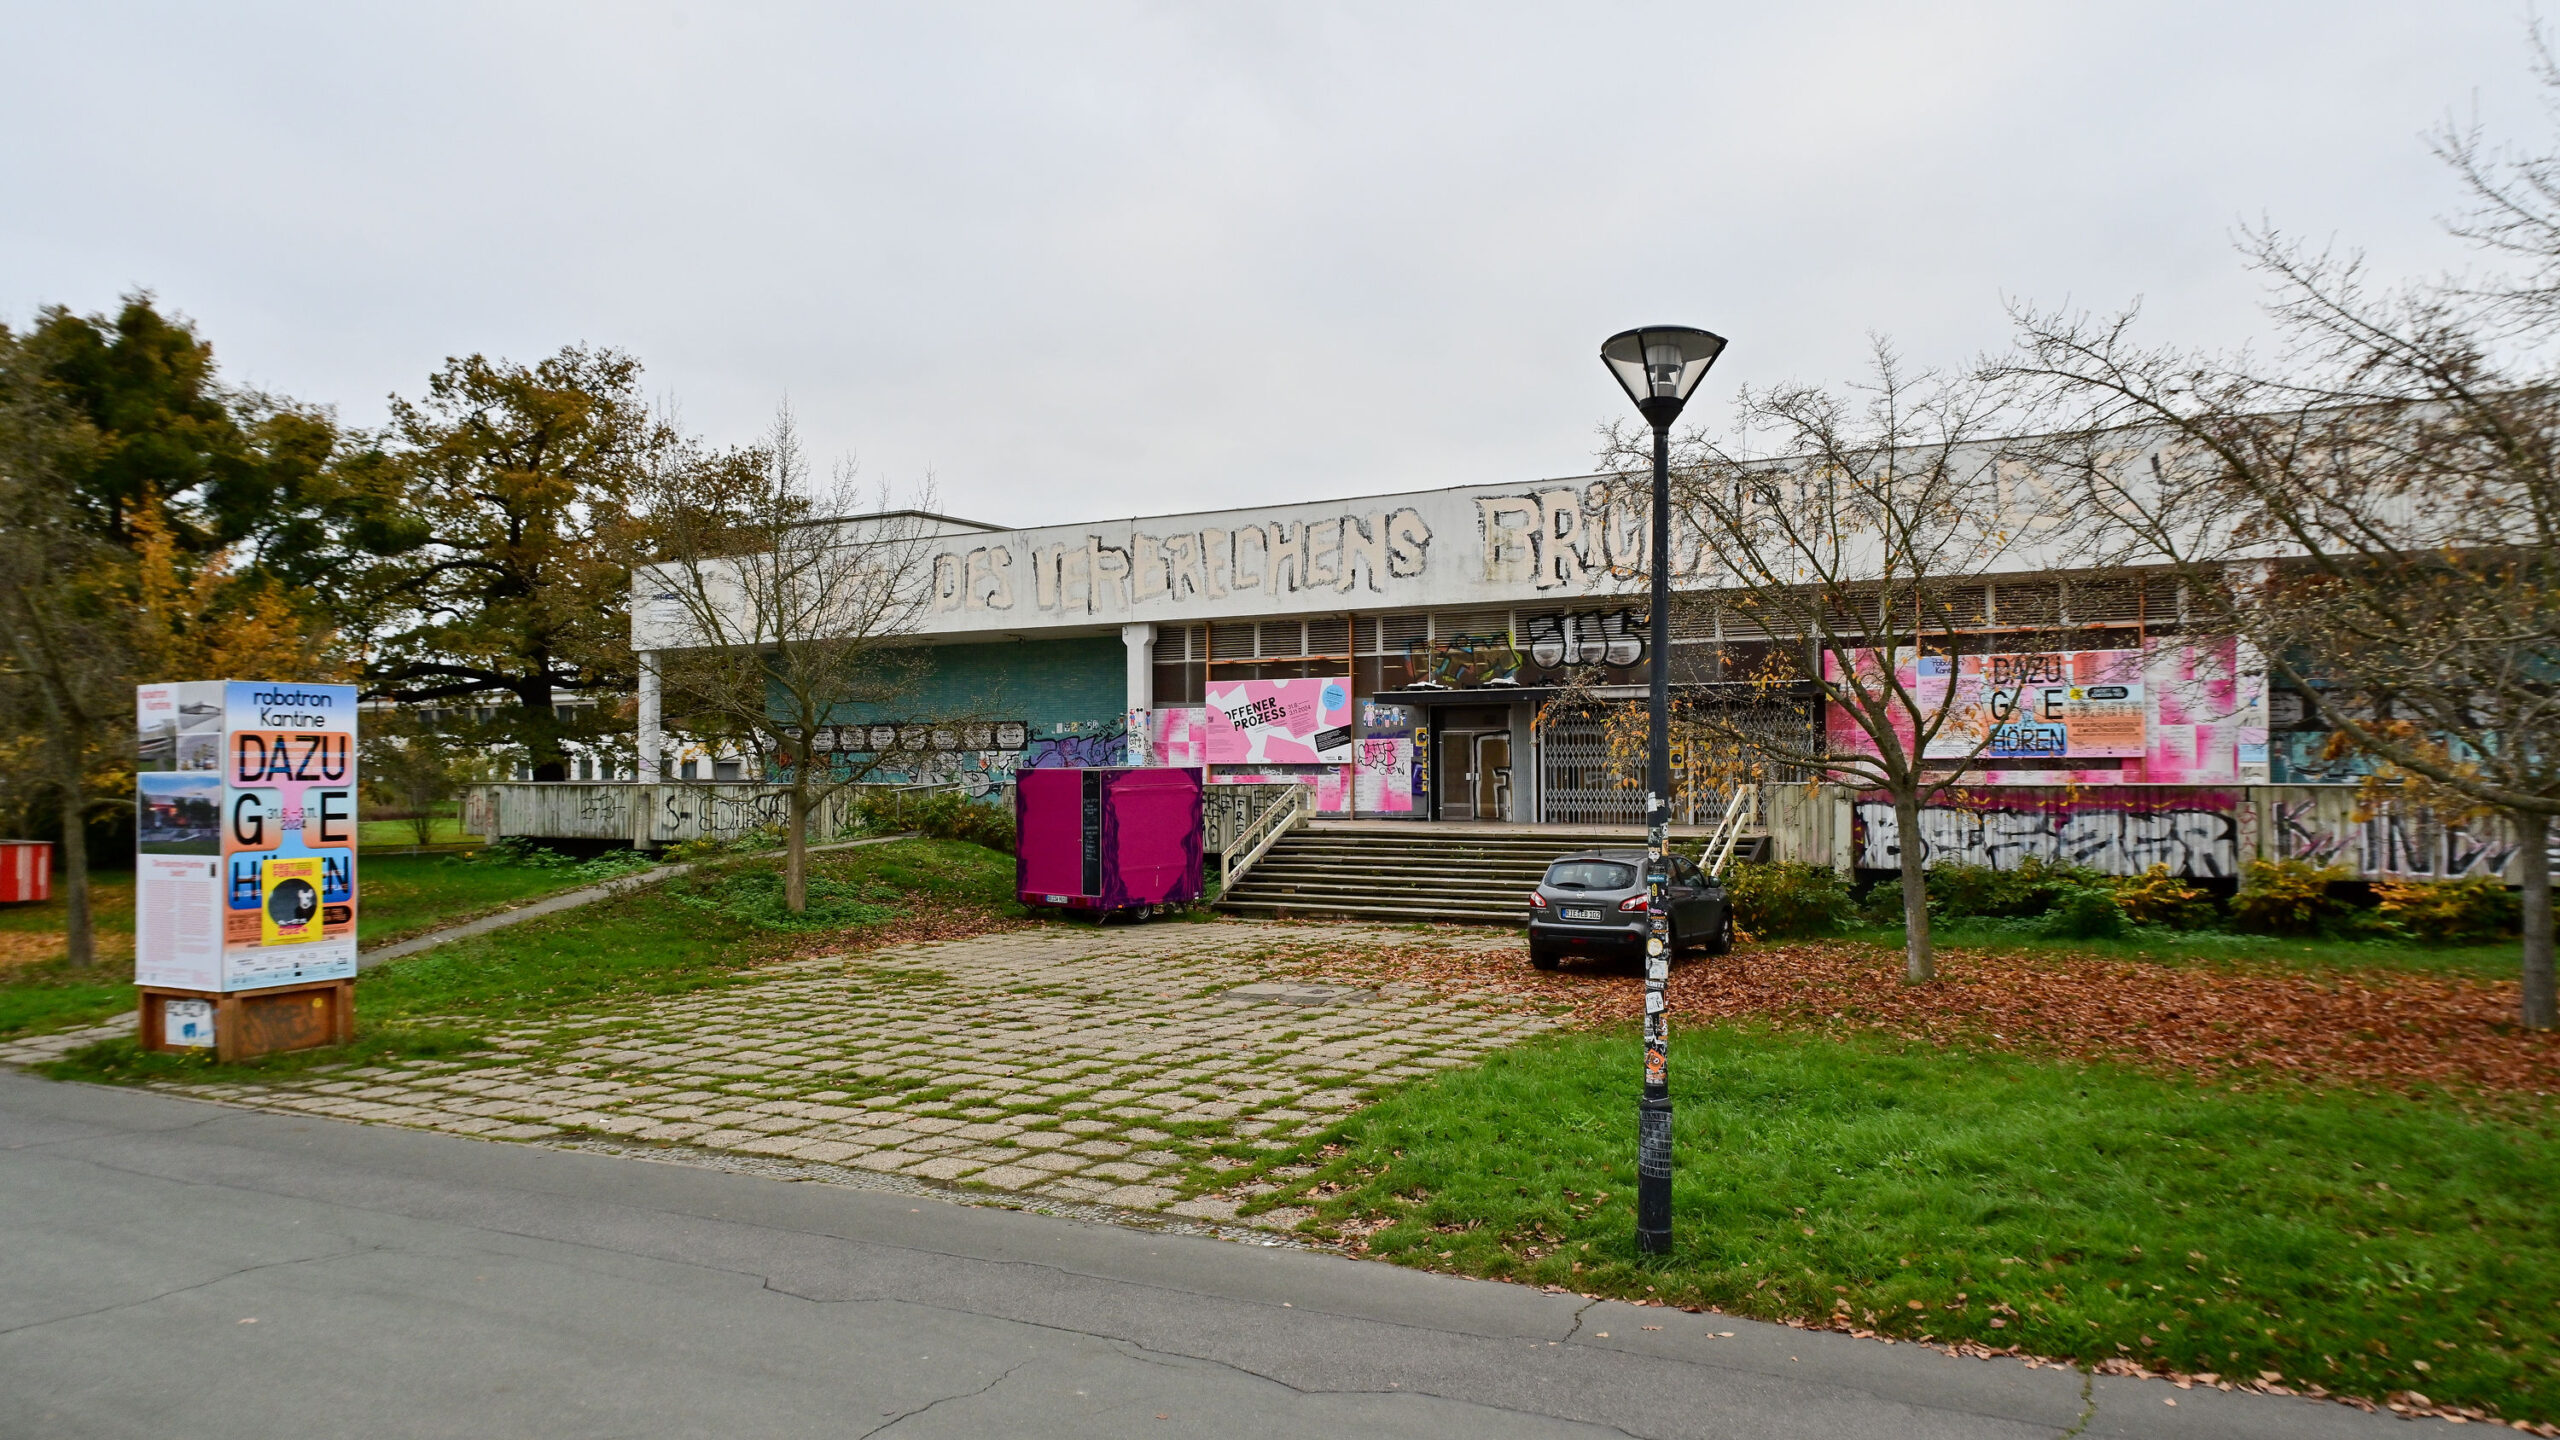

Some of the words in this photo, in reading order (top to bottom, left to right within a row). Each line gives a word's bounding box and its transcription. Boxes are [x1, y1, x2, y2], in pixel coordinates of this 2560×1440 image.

[933, 545, 1013, 614] DES
[253, 686, 333, 708] robotron
[1224, 696, 1278, 720] OFFENER
[260, 706, 326, 728] Kantine
[1233, 707, 1287, 732] PROZESS
[1991, 725, 2065, 751] HÖREN
[238, 734, 346, 782] DAZU
[233, 792, 263, 845] G
[320, 791, 348, 842] E
